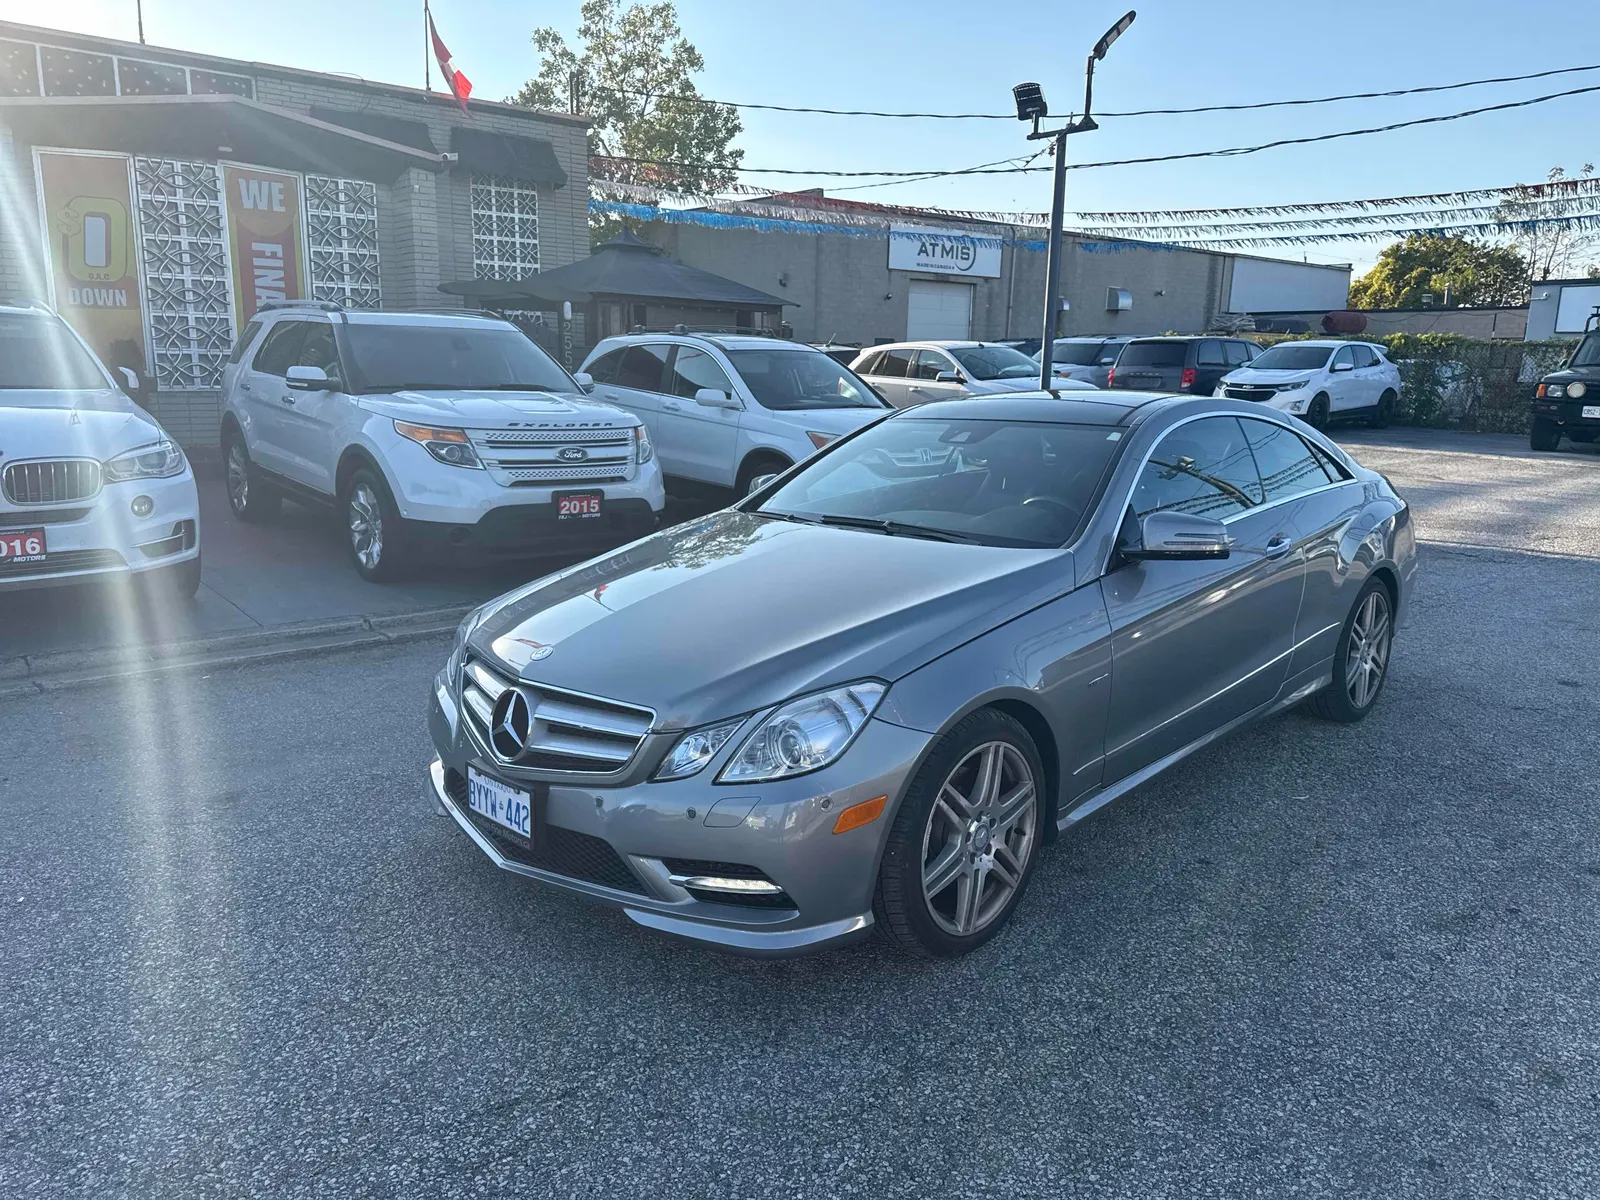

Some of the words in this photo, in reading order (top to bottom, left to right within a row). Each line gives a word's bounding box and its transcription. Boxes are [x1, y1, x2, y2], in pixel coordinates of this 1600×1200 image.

[238, 178, 286, 212] WE
[917, 241, 971, 261] ATMIS
[68, 287, 128, 307] DOWN
[564, 449, 583, 459] Ford
[560, 500, 599, 515] 2015
[13, 554, 47, 563] MOTORS
[469, 778, 498, 819] BYYW
[505, 797, 530, 835] 442
